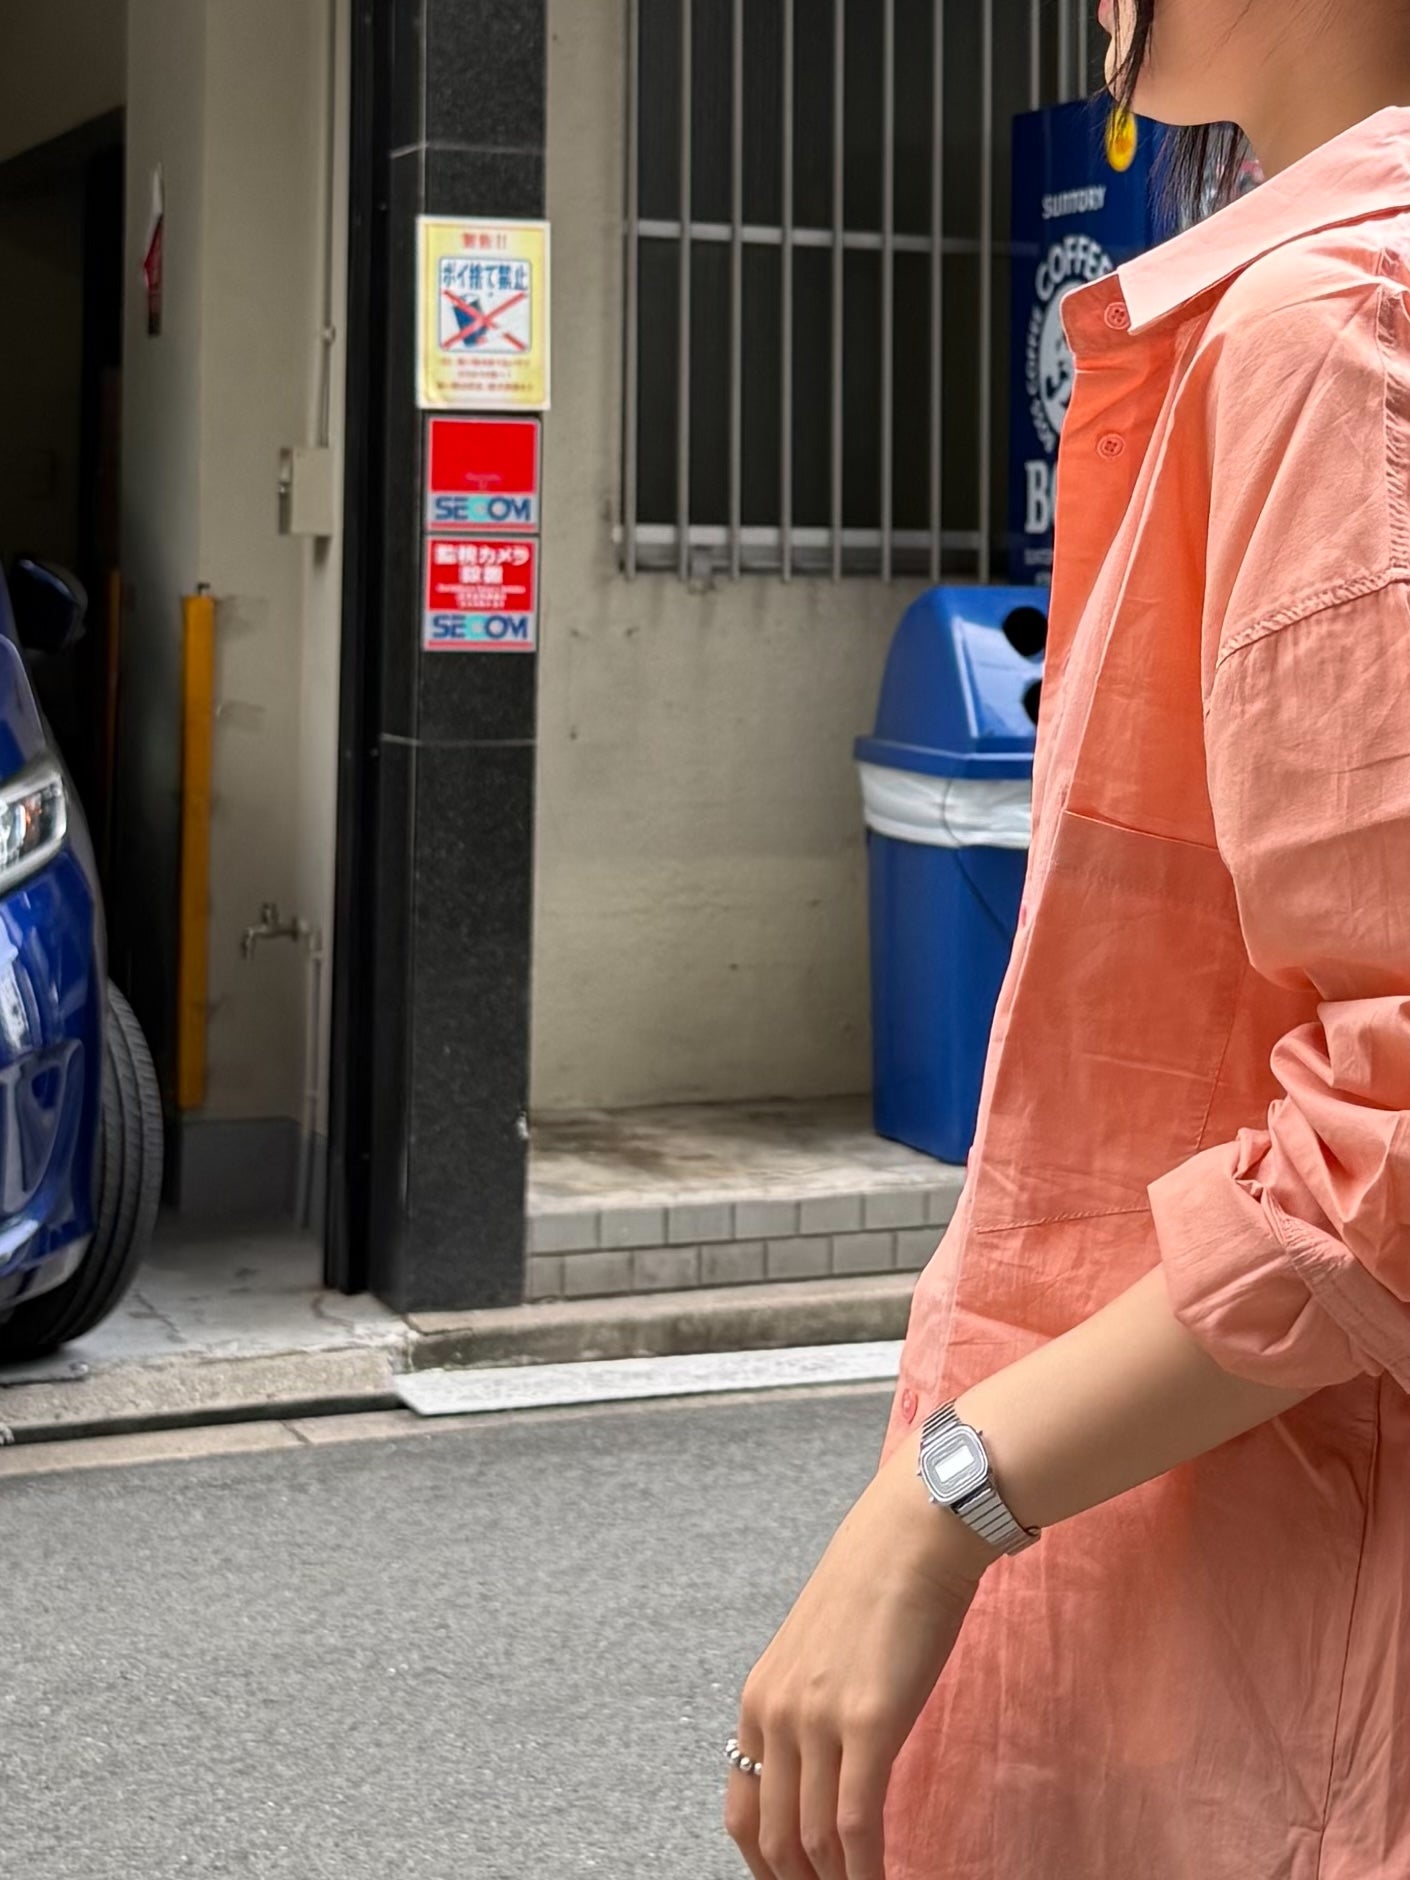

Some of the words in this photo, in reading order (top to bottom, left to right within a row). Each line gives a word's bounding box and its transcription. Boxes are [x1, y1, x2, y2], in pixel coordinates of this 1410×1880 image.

[1041, 185, 1106, 219] SUNTORY
[434, 496, 531, 522] SECOM
[432, 614, 529, 640] SECOM
